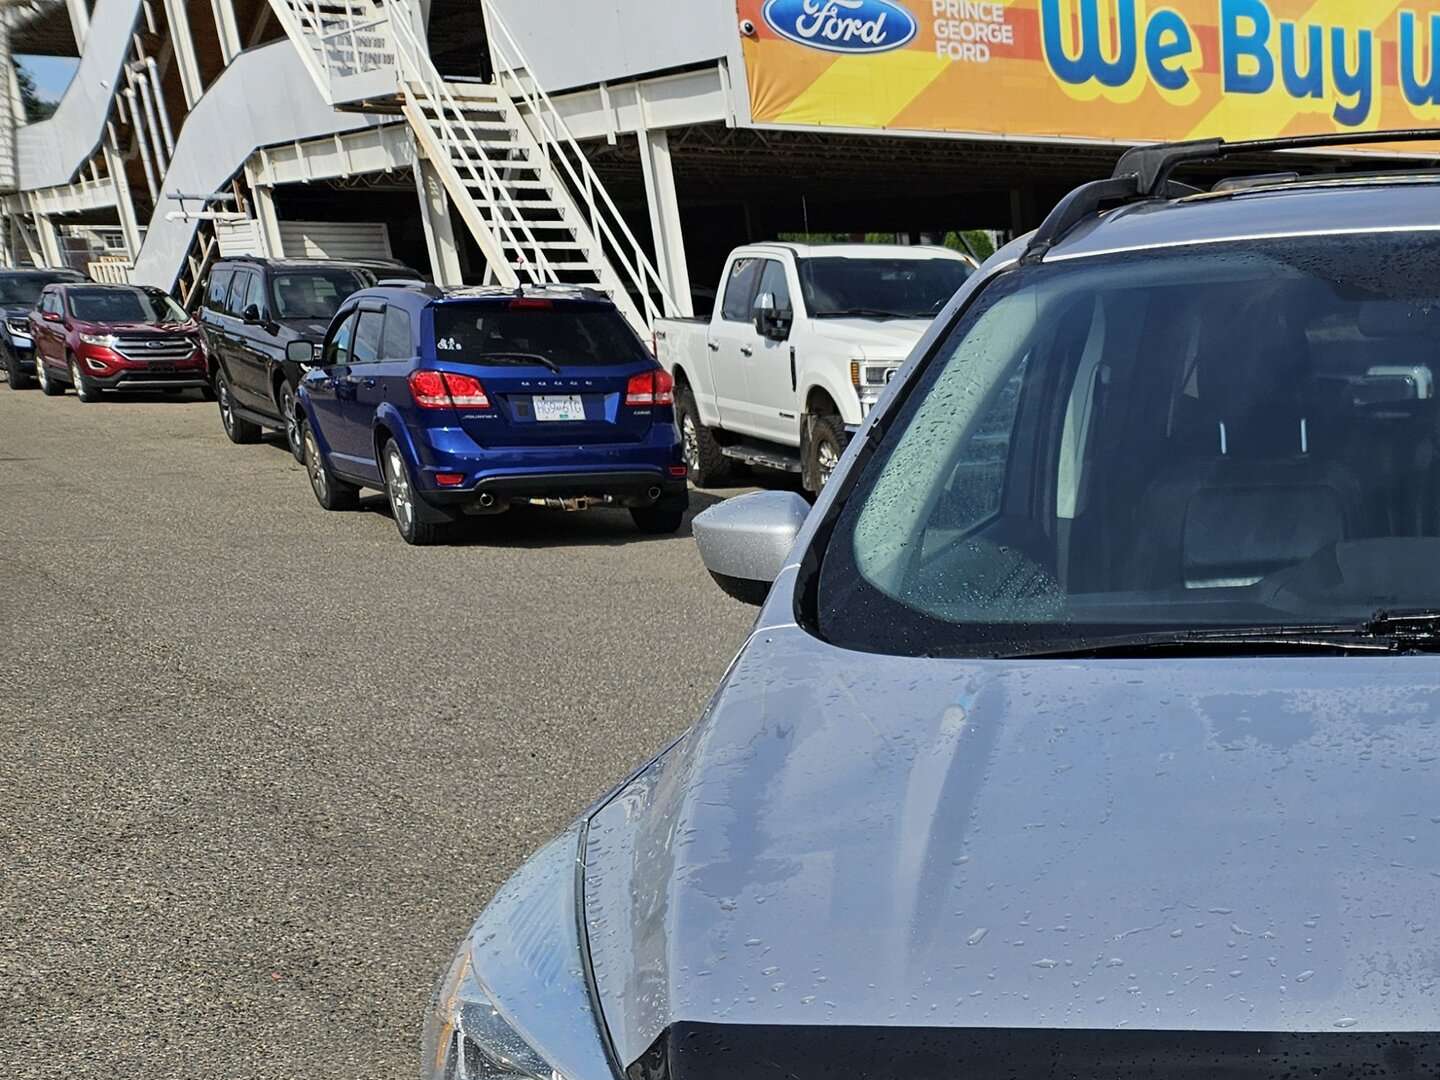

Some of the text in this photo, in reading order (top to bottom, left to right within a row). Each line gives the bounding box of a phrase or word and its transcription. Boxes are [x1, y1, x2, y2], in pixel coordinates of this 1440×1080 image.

[795, 0, 888, 45] Ford
[931, 0, 1005, 23] PRINCE
[933, 18, 1014, 45] GEORGE
[935, 39, 991, 63] FORD
[1040, 0, 1193, 91] We
[1219, 0, 1374, 127] Buy
